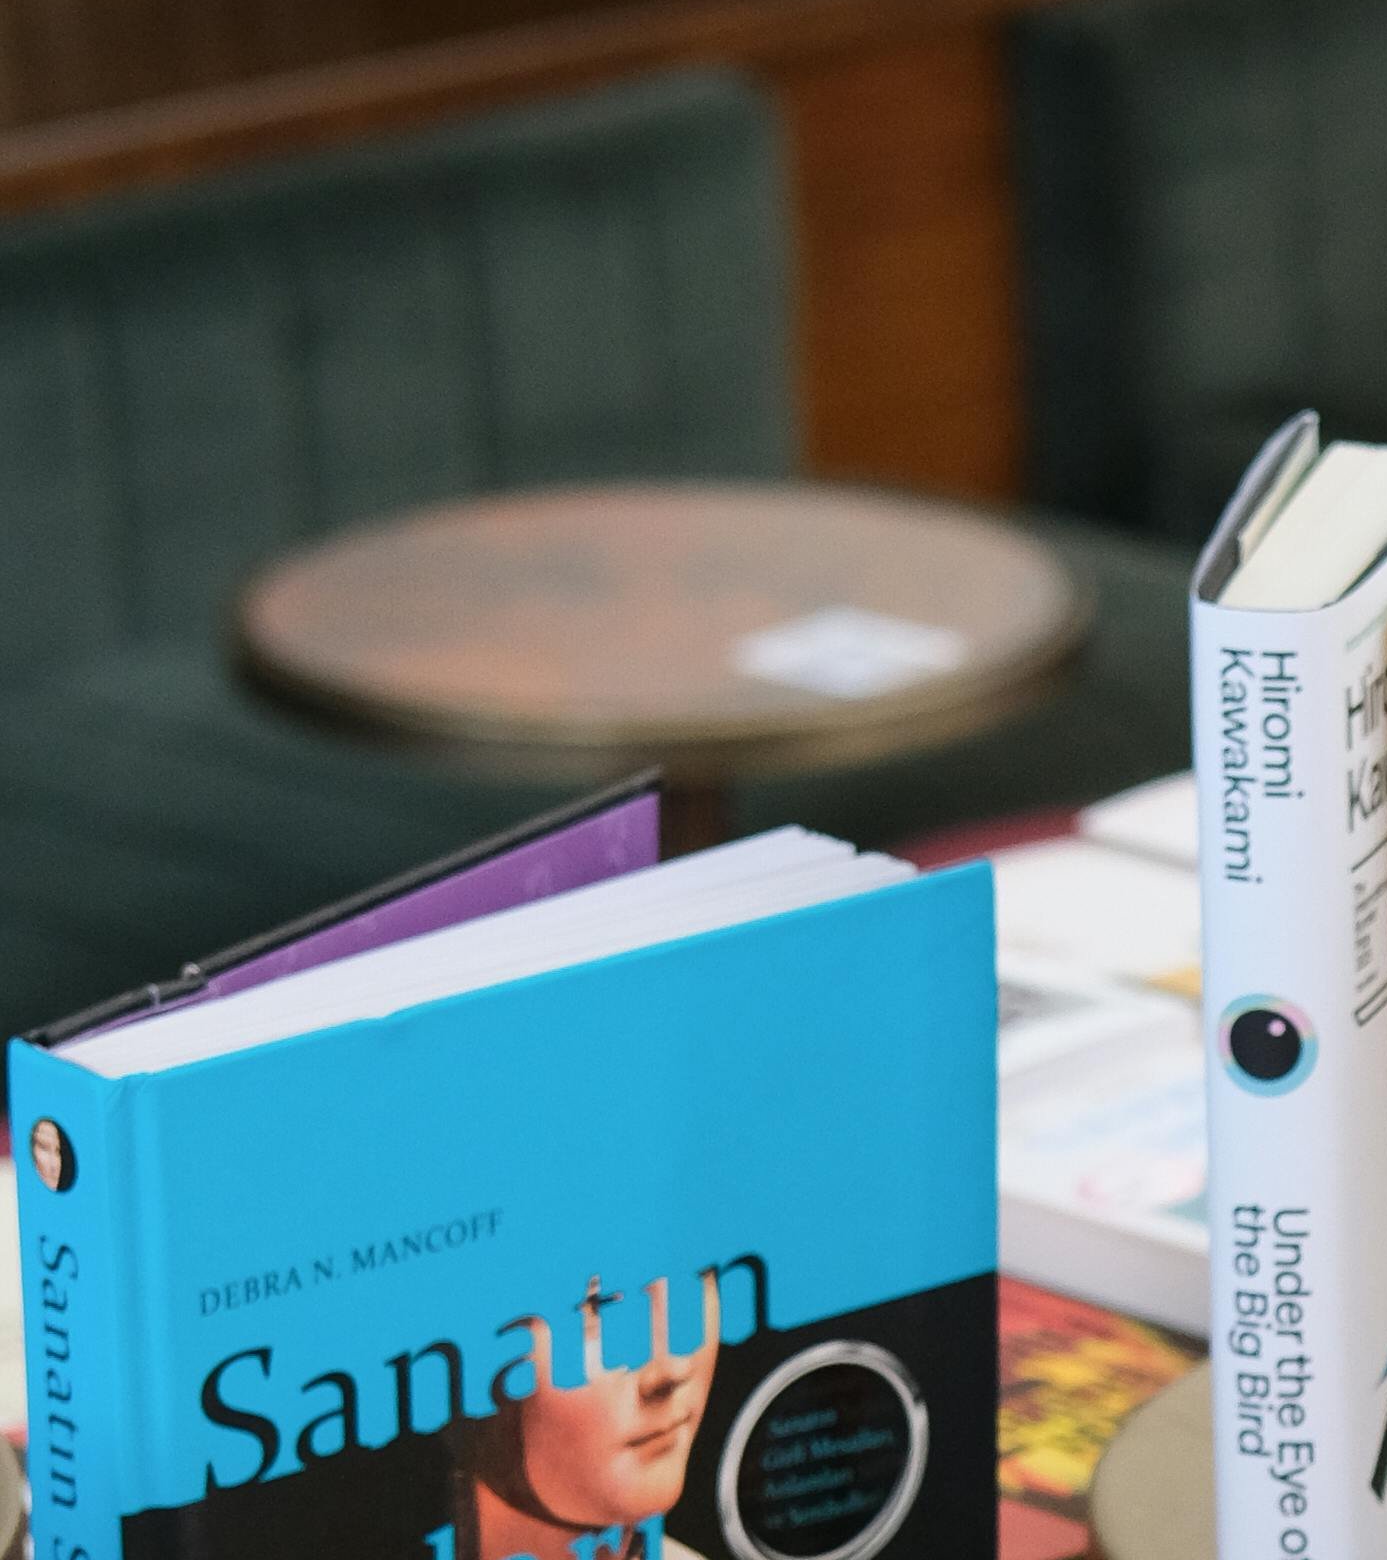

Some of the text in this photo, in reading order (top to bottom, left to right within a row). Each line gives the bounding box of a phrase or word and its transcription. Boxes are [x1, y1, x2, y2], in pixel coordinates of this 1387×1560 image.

[1220, 647, 1263, 884] Kawakami
[1261, 651, 1303, 799] Hiromi
[199, 1209, 505, 1317] DEBRA N. MANCOFF
[1231, 1205, 1274, 1457] the Big Bird
[1274, 1209, 1312, 1345] Under
[39, 1237, 78, 1510] Sanatın
[200, 1252, 770, 1498] Sanatın
[1277, 1355, 1313, 1427] the
[1271, 1439, 1313, 1515] Eye
